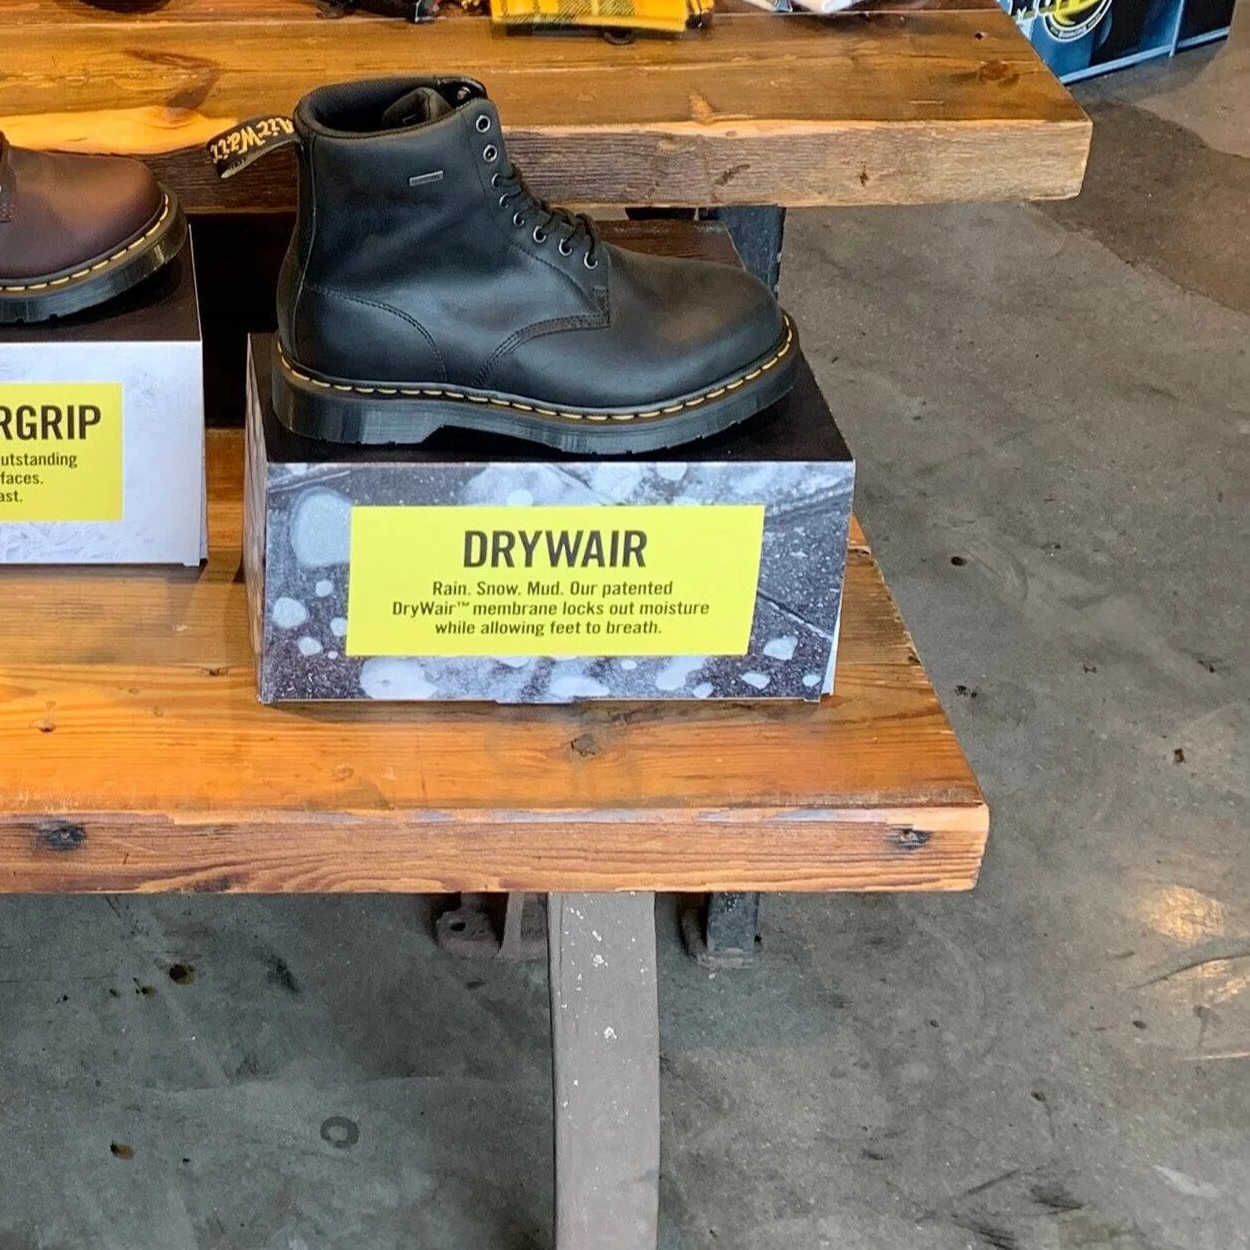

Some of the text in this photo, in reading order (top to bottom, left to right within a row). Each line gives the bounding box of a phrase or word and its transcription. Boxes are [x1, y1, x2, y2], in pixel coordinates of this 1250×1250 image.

[463, 529, 648, 568] DRYWAIR
[432, 580, 674, 599] Rain. Snow. Mud. Our patented
[472, 601, 558, 616] membrane
[562, 601, 605, 616] locks
[608, 603, 635, 616] out
[638, 601, 710, 616] moisture
[434, 620, 662, 638] while allowing feet to breath.
